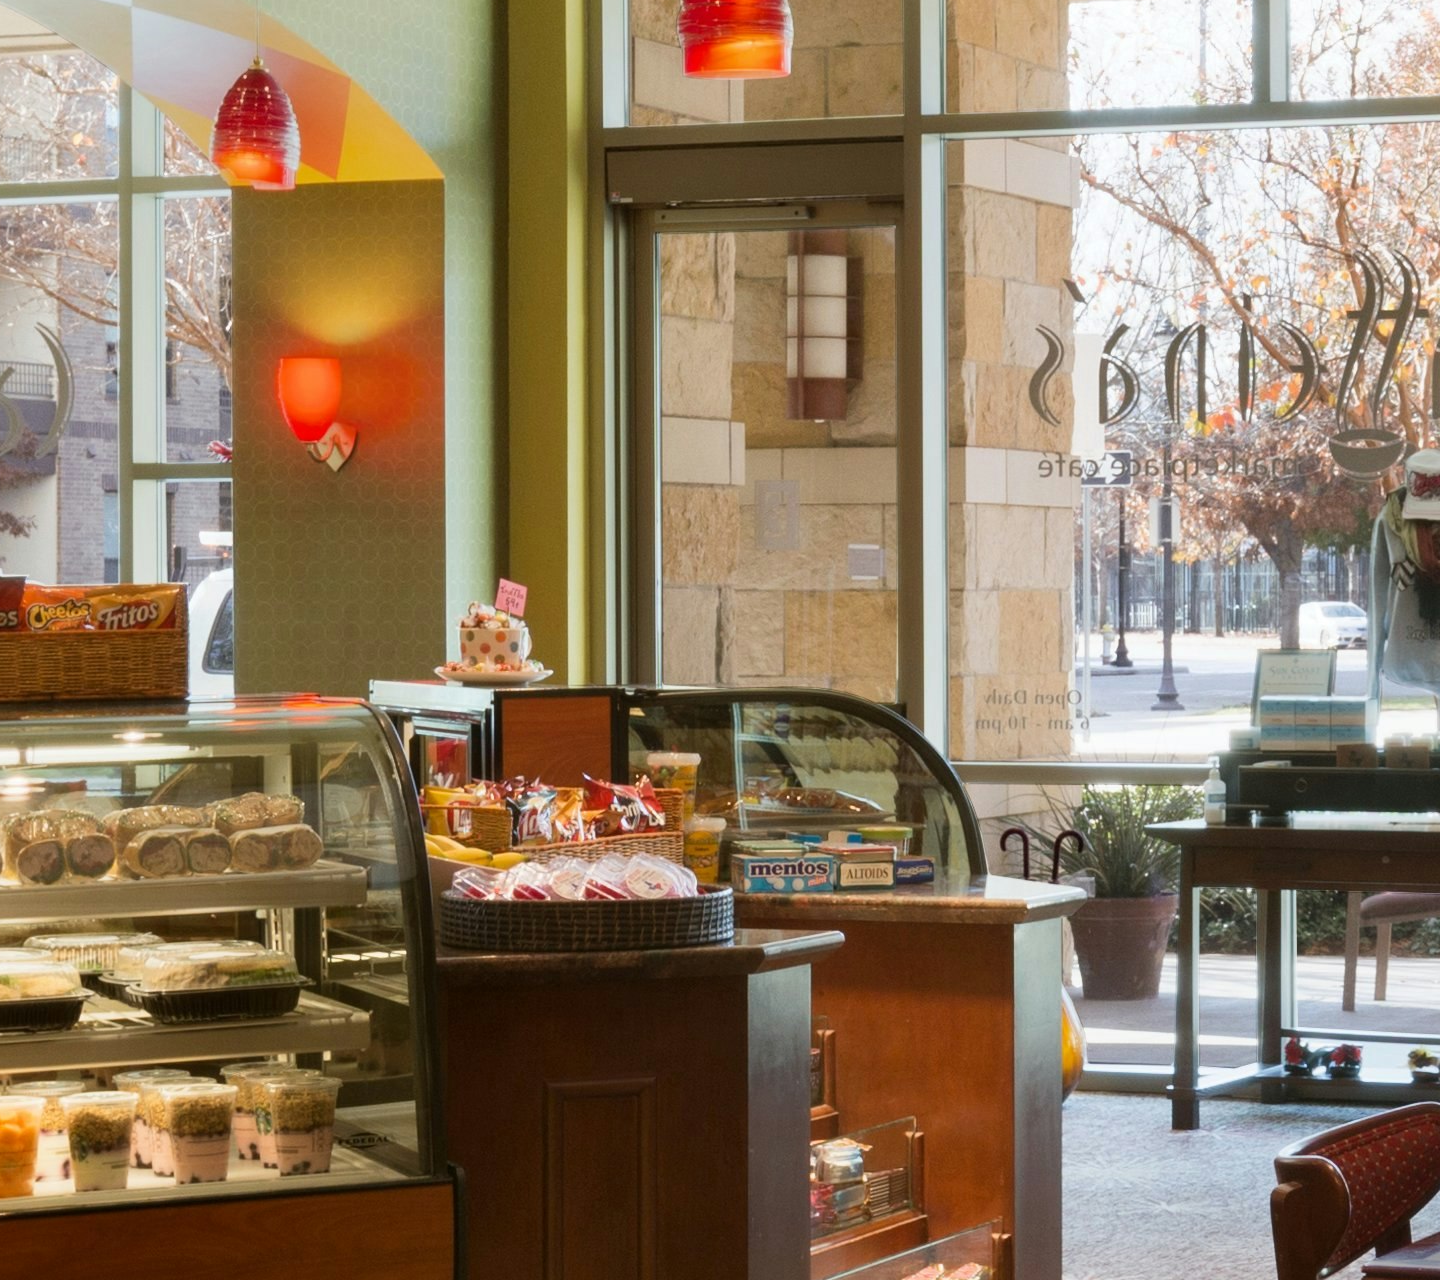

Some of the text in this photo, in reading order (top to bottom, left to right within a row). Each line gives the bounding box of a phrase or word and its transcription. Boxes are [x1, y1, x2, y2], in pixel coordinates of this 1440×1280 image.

[27, 599, 91, 630] Cheetos
[97, 602, 158, 630] Fritos
[750, 861, 829, 877] mentos
[846, 867, 889, 880] ALTOIDS
